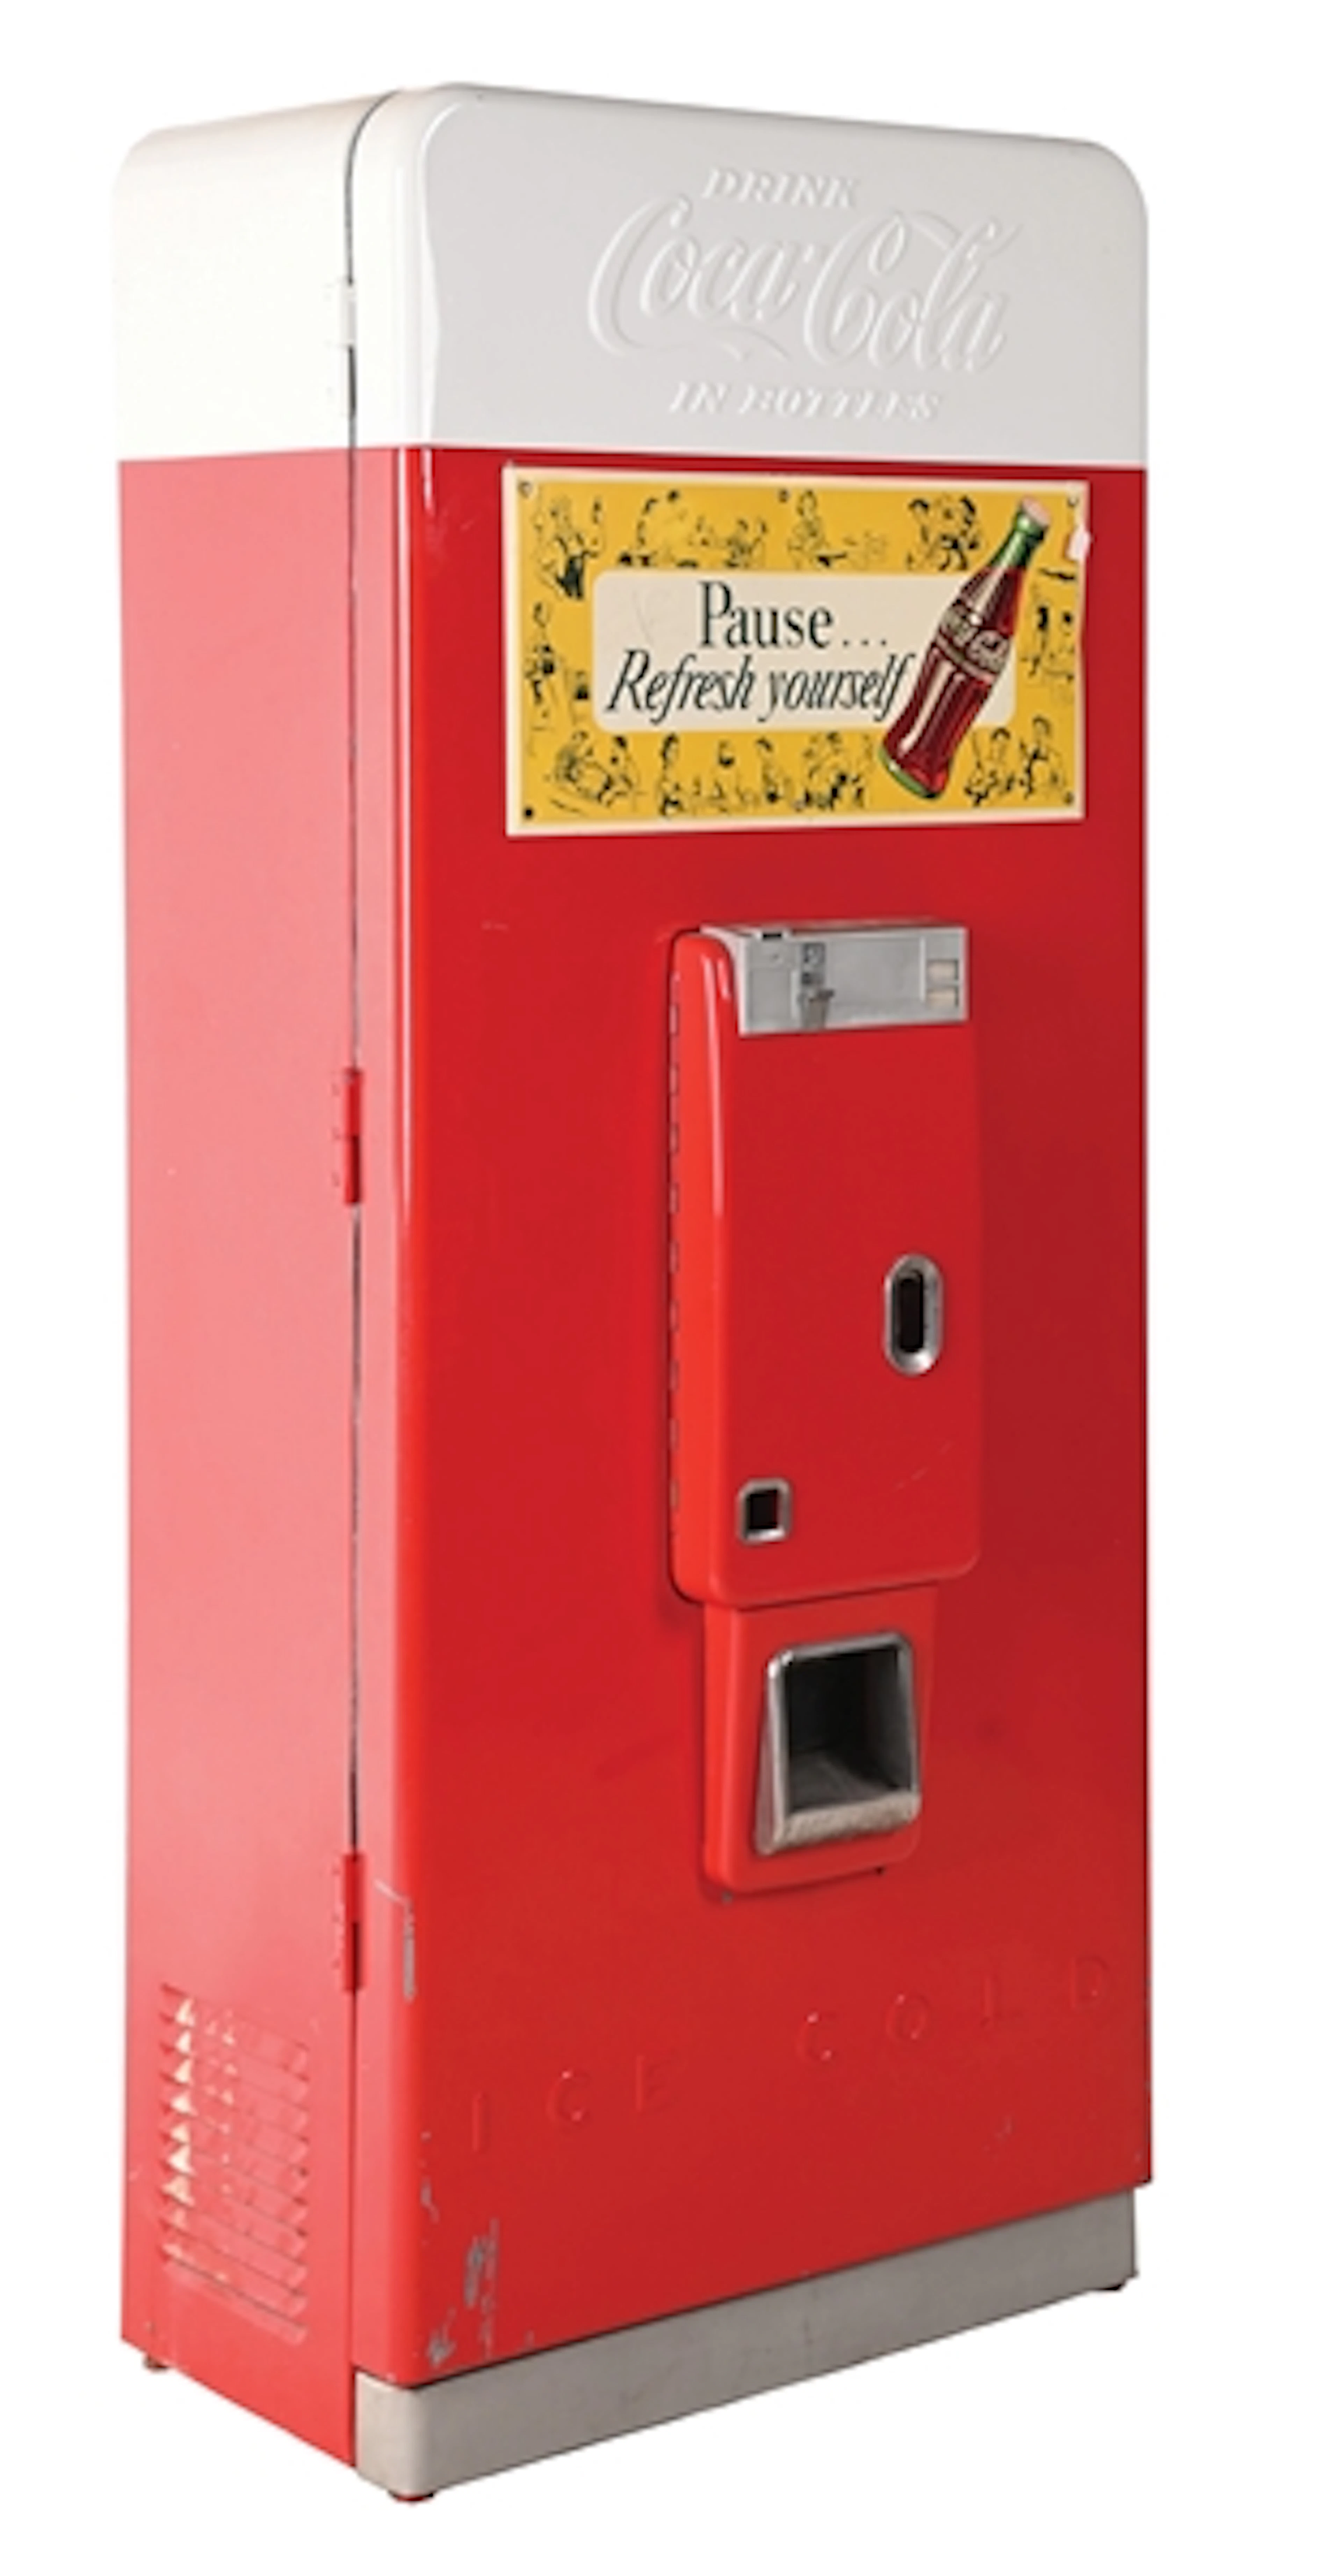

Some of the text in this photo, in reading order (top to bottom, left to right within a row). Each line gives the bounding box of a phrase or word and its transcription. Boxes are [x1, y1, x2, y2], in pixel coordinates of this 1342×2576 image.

[702, 166, 860, 208] DRINK
[587, 191, 1024, 375] Coca-Cola
[668, 380, 941, 422] IN BOTTLES
[605, 649, 914, 724] Refresh yourself
[472, 1954, 1111, 2154] ICE COLD
